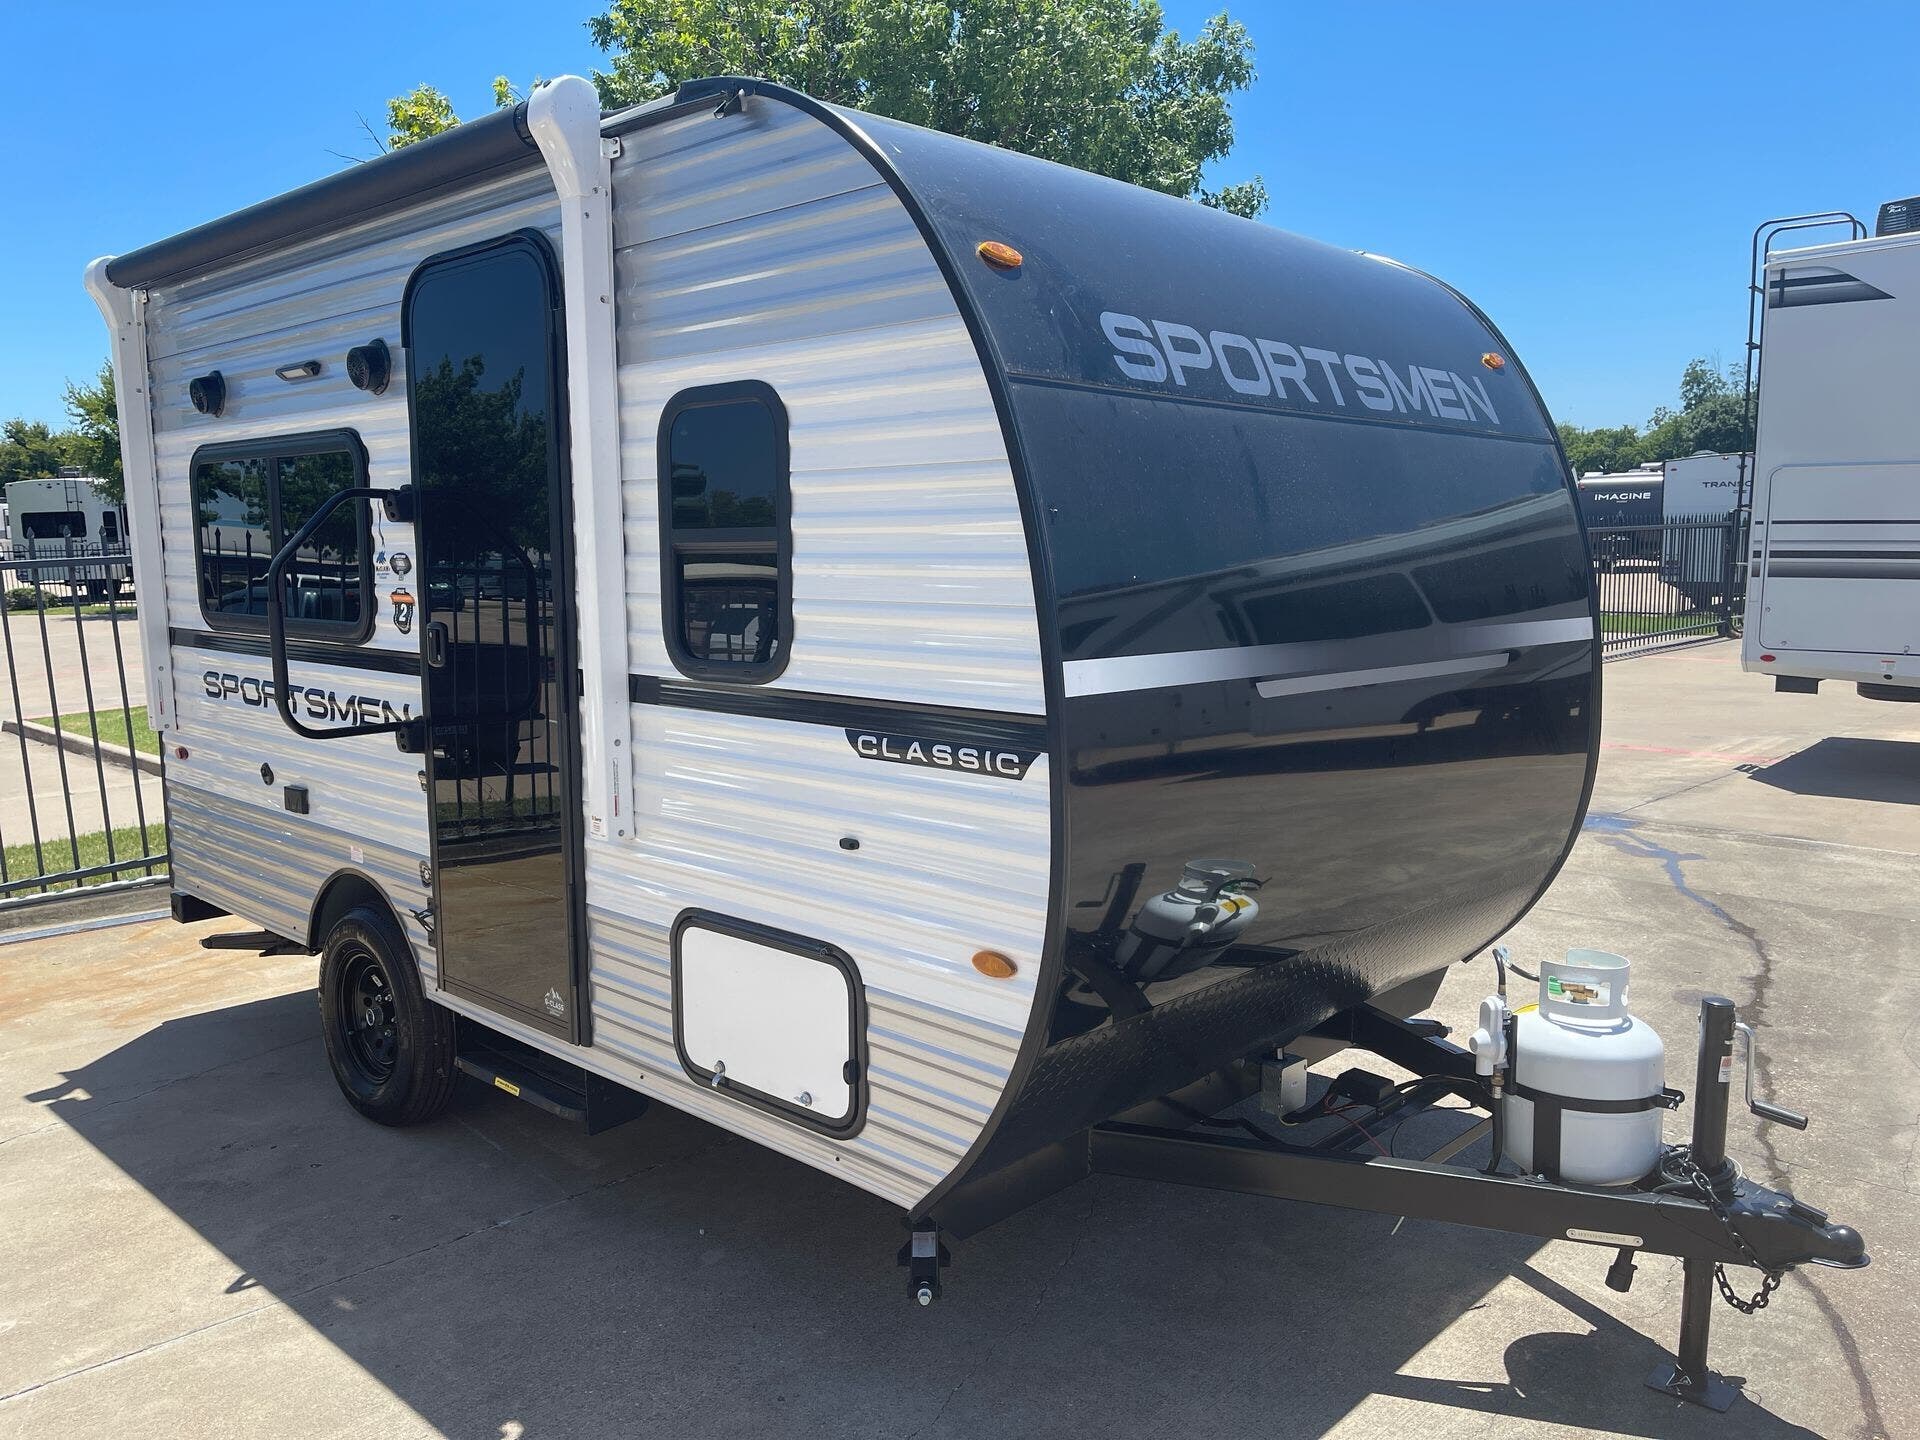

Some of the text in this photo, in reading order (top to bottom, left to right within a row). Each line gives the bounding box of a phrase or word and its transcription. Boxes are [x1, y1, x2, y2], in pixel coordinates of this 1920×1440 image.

[1100, 311, 1500, 425] SPORTSMEN
[1594, 492, 1651, 501] IMAGINE
[398, 602, 408, 622] 2
[857, 734, 1020, 775] CLASSIC
